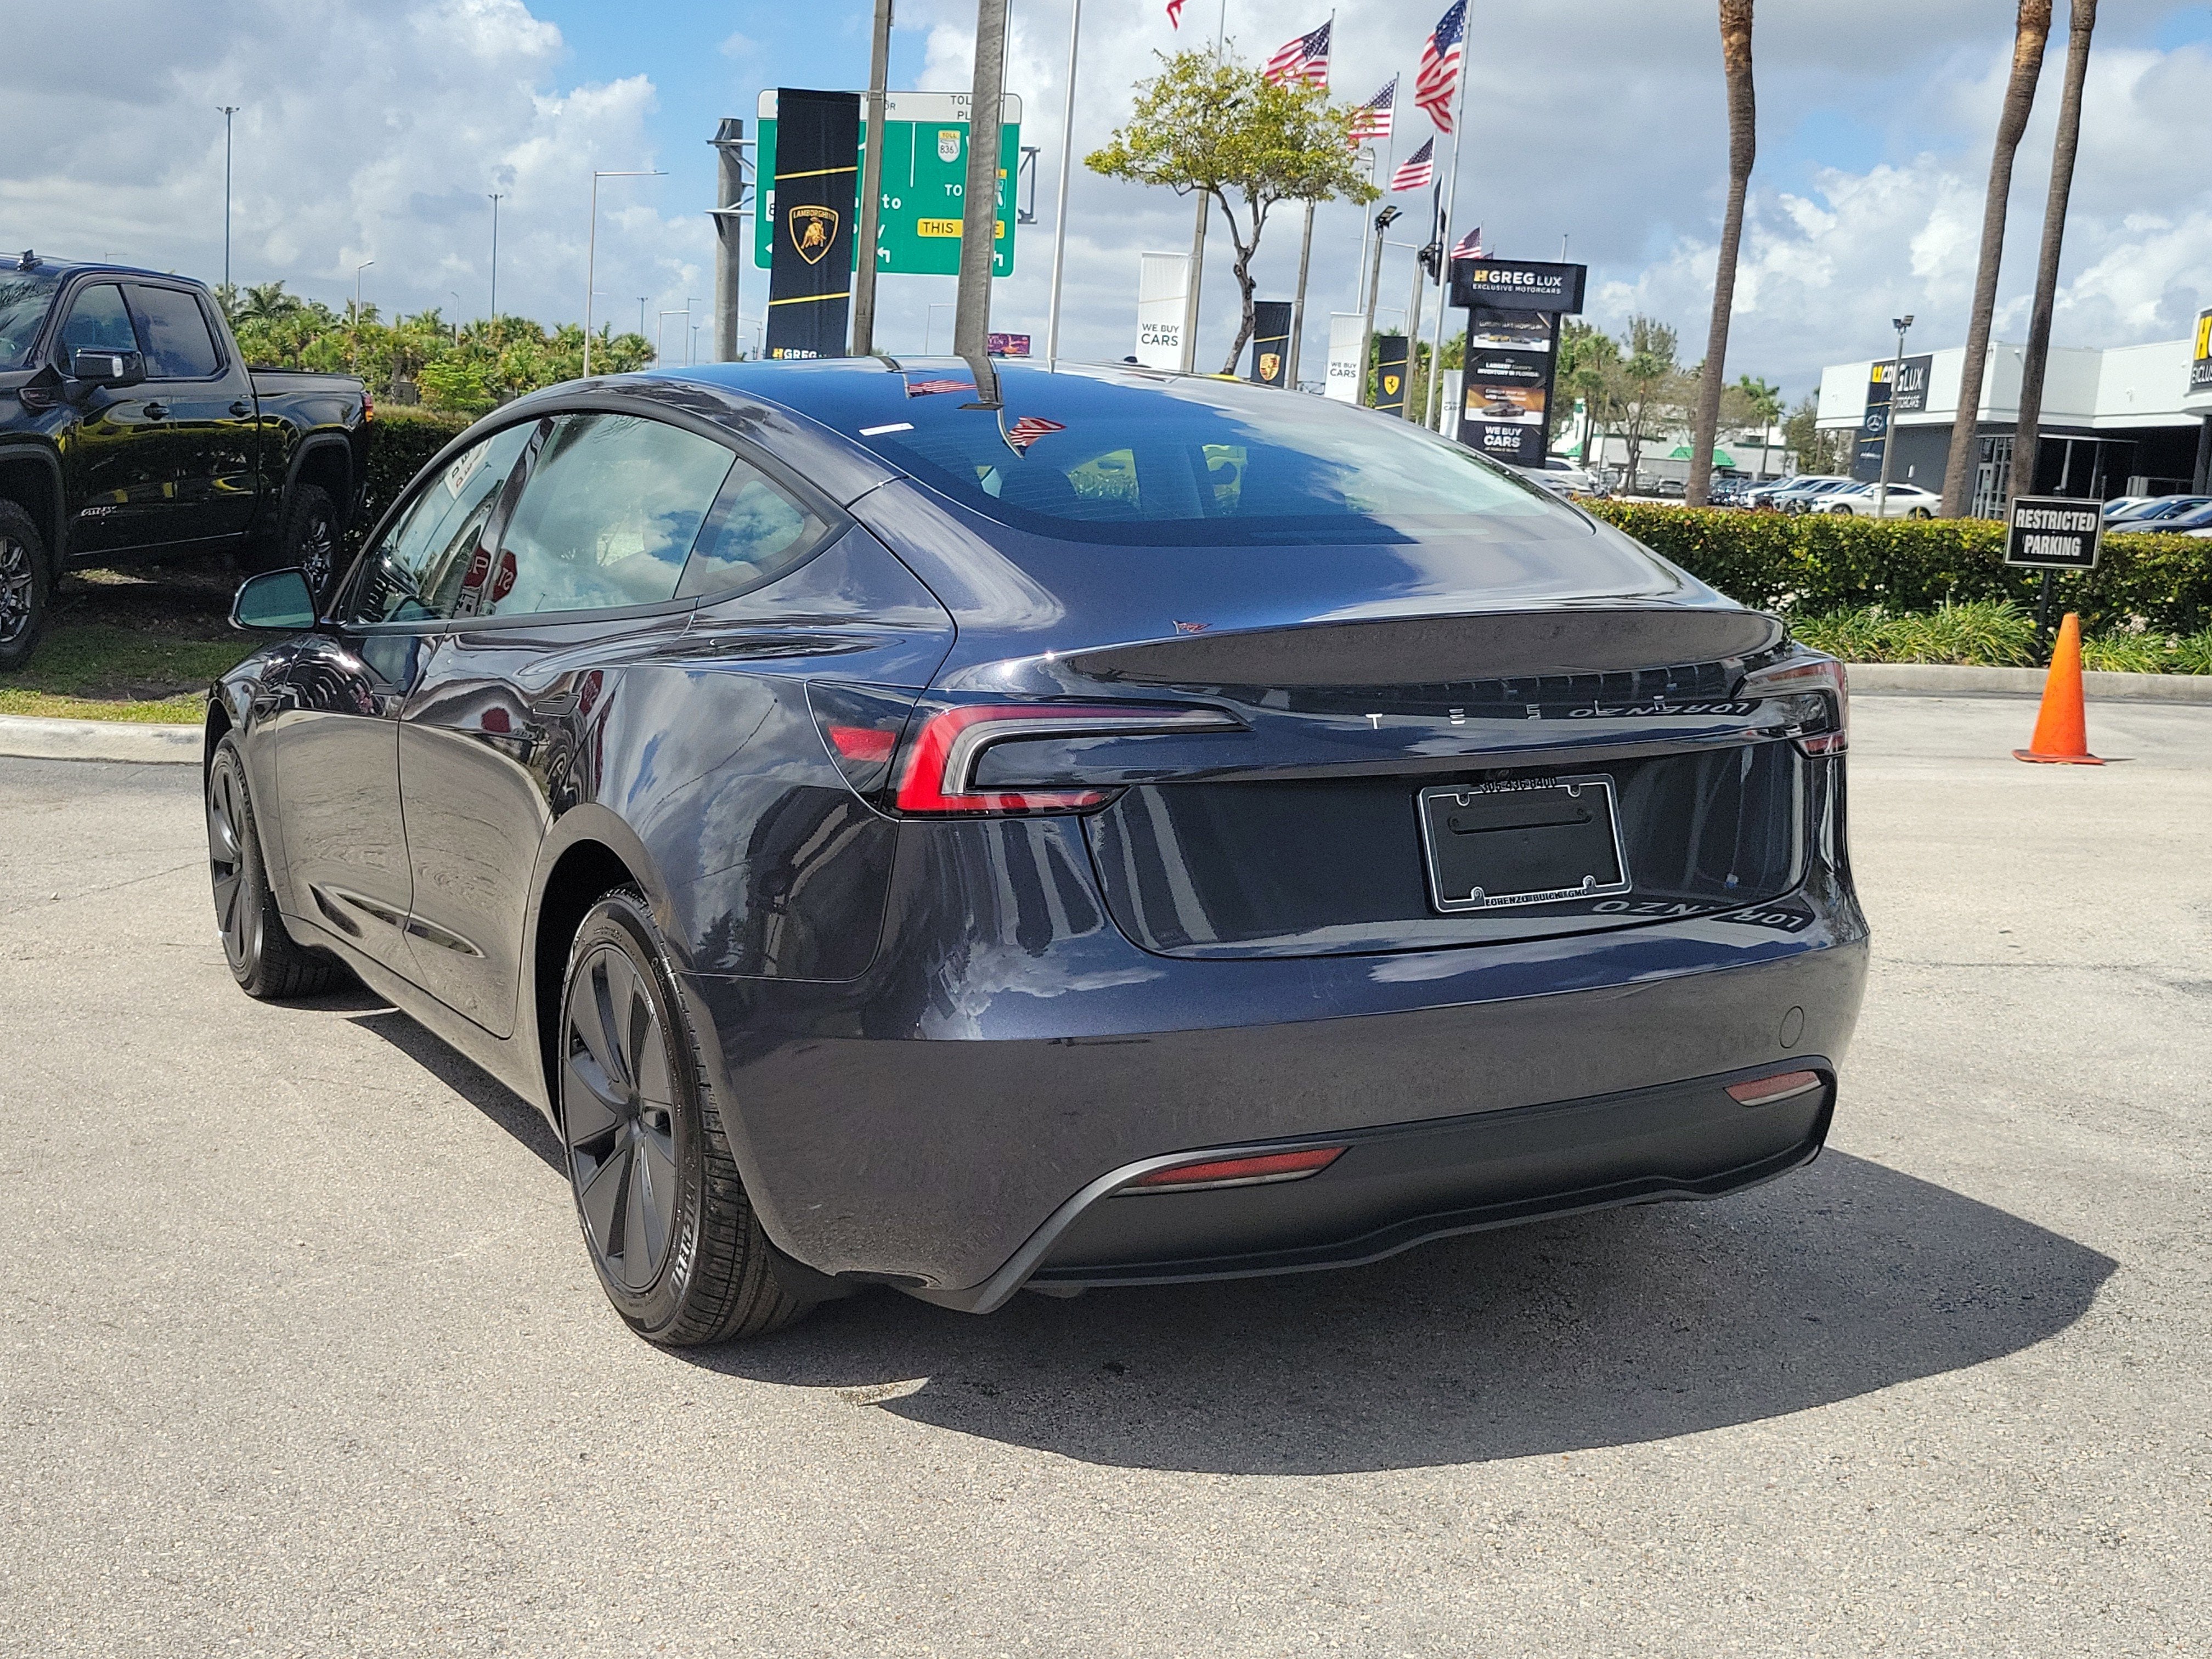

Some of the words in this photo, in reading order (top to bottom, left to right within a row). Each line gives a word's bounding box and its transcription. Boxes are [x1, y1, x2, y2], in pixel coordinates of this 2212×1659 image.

[950, 95, 972, 105] TOL
[940, 144, 955, 154] 836
[944, 184, 963, 196] TO
[881, 194, 901, 209] to
[923, 222, 954, 234] THIS
[1537, 275, 1562, 287] LUX
[1472, 284, 1512, 292] EXCLUSIVE
[1515, 286, 1561, 295] MOTORCARS
[1142, 323, 1158, 332] WE
[1160, 325, 1180, 334] BUY
[1141, 333, 1178, 346] CARS
[1330, 368, 1356, 378] CARS
[1904, 366, 1924, 391] LUX
[1485, 425, 1501, 435] WE
[1502, 427, 1523, 436] BUY
[1483, 435, 1521, 448] CARS
[2015, 508, 2097, 532] RESTRICTED
[2023, 534, 2083, 557] PARKING
[1485, 896, 1528, 906] LORENZO
[1533, 892, 1562, 901] BUICK
[1568, 889, 1588, 898] GMC
